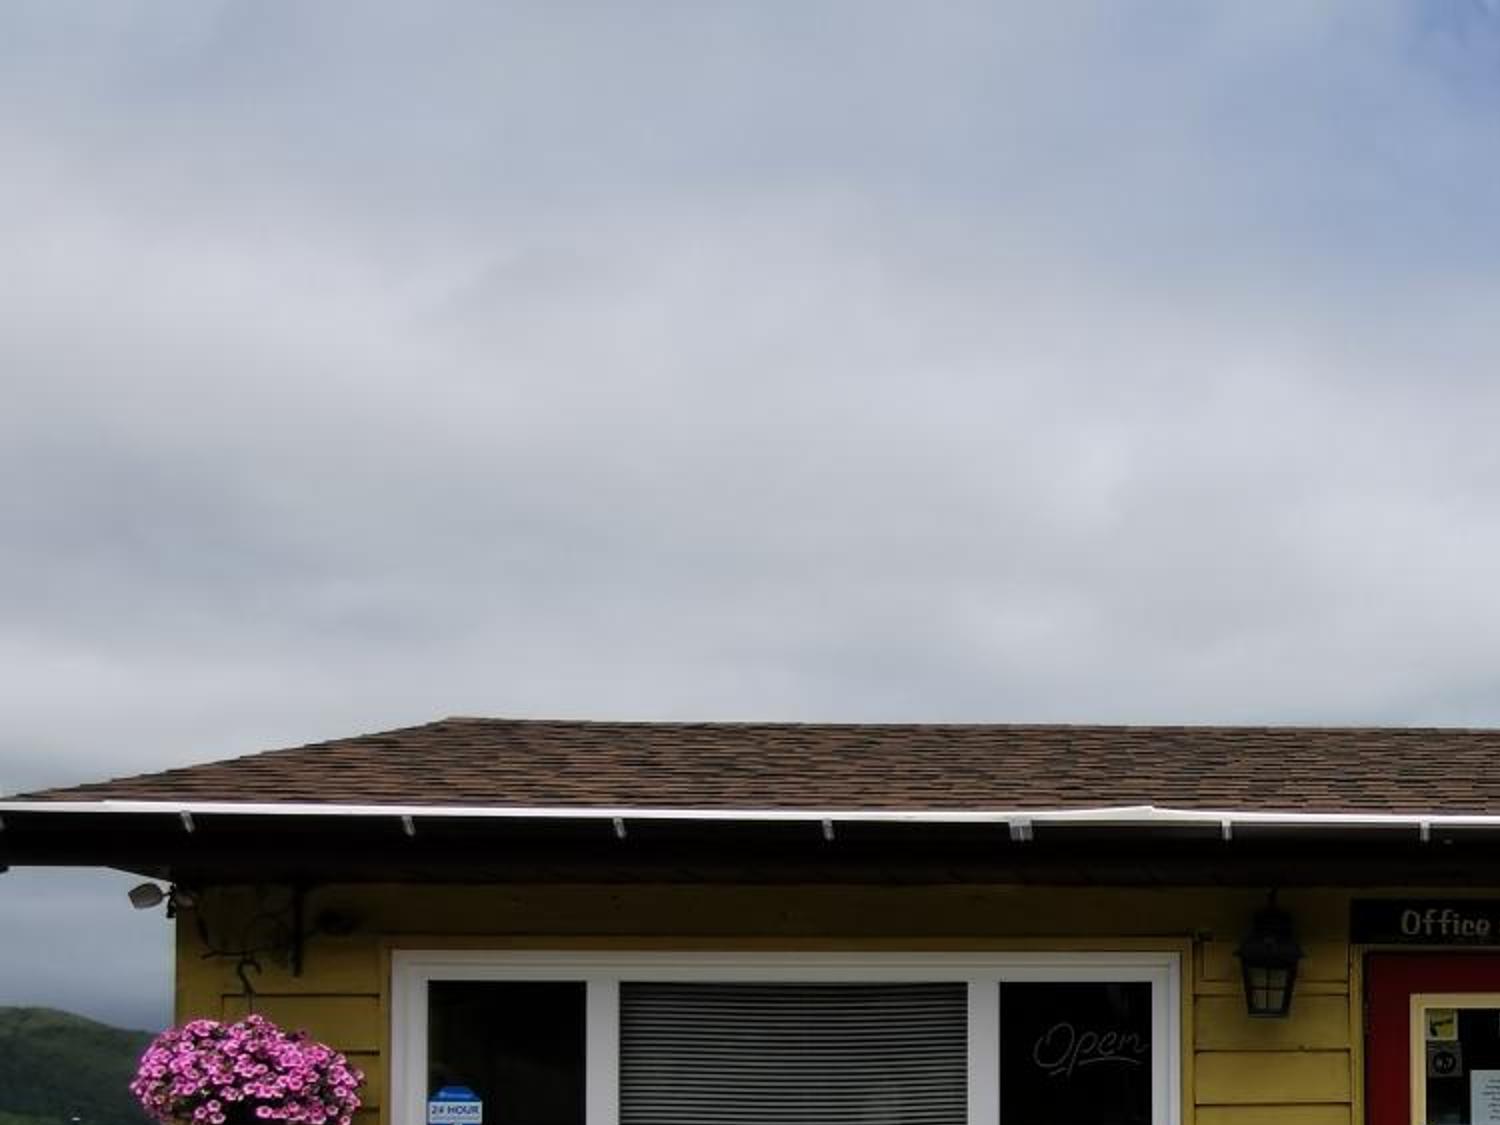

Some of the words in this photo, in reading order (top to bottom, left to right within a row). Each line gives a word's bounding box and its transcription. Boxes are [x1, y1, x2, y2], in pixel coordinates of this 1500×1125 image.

[1402, 909, 1491, 937] Office
[1033, 1022, 1149, 1076] Open
[431, 1105, 444, 1115] 24
[447, 1105, 480, 1115] HOUR
